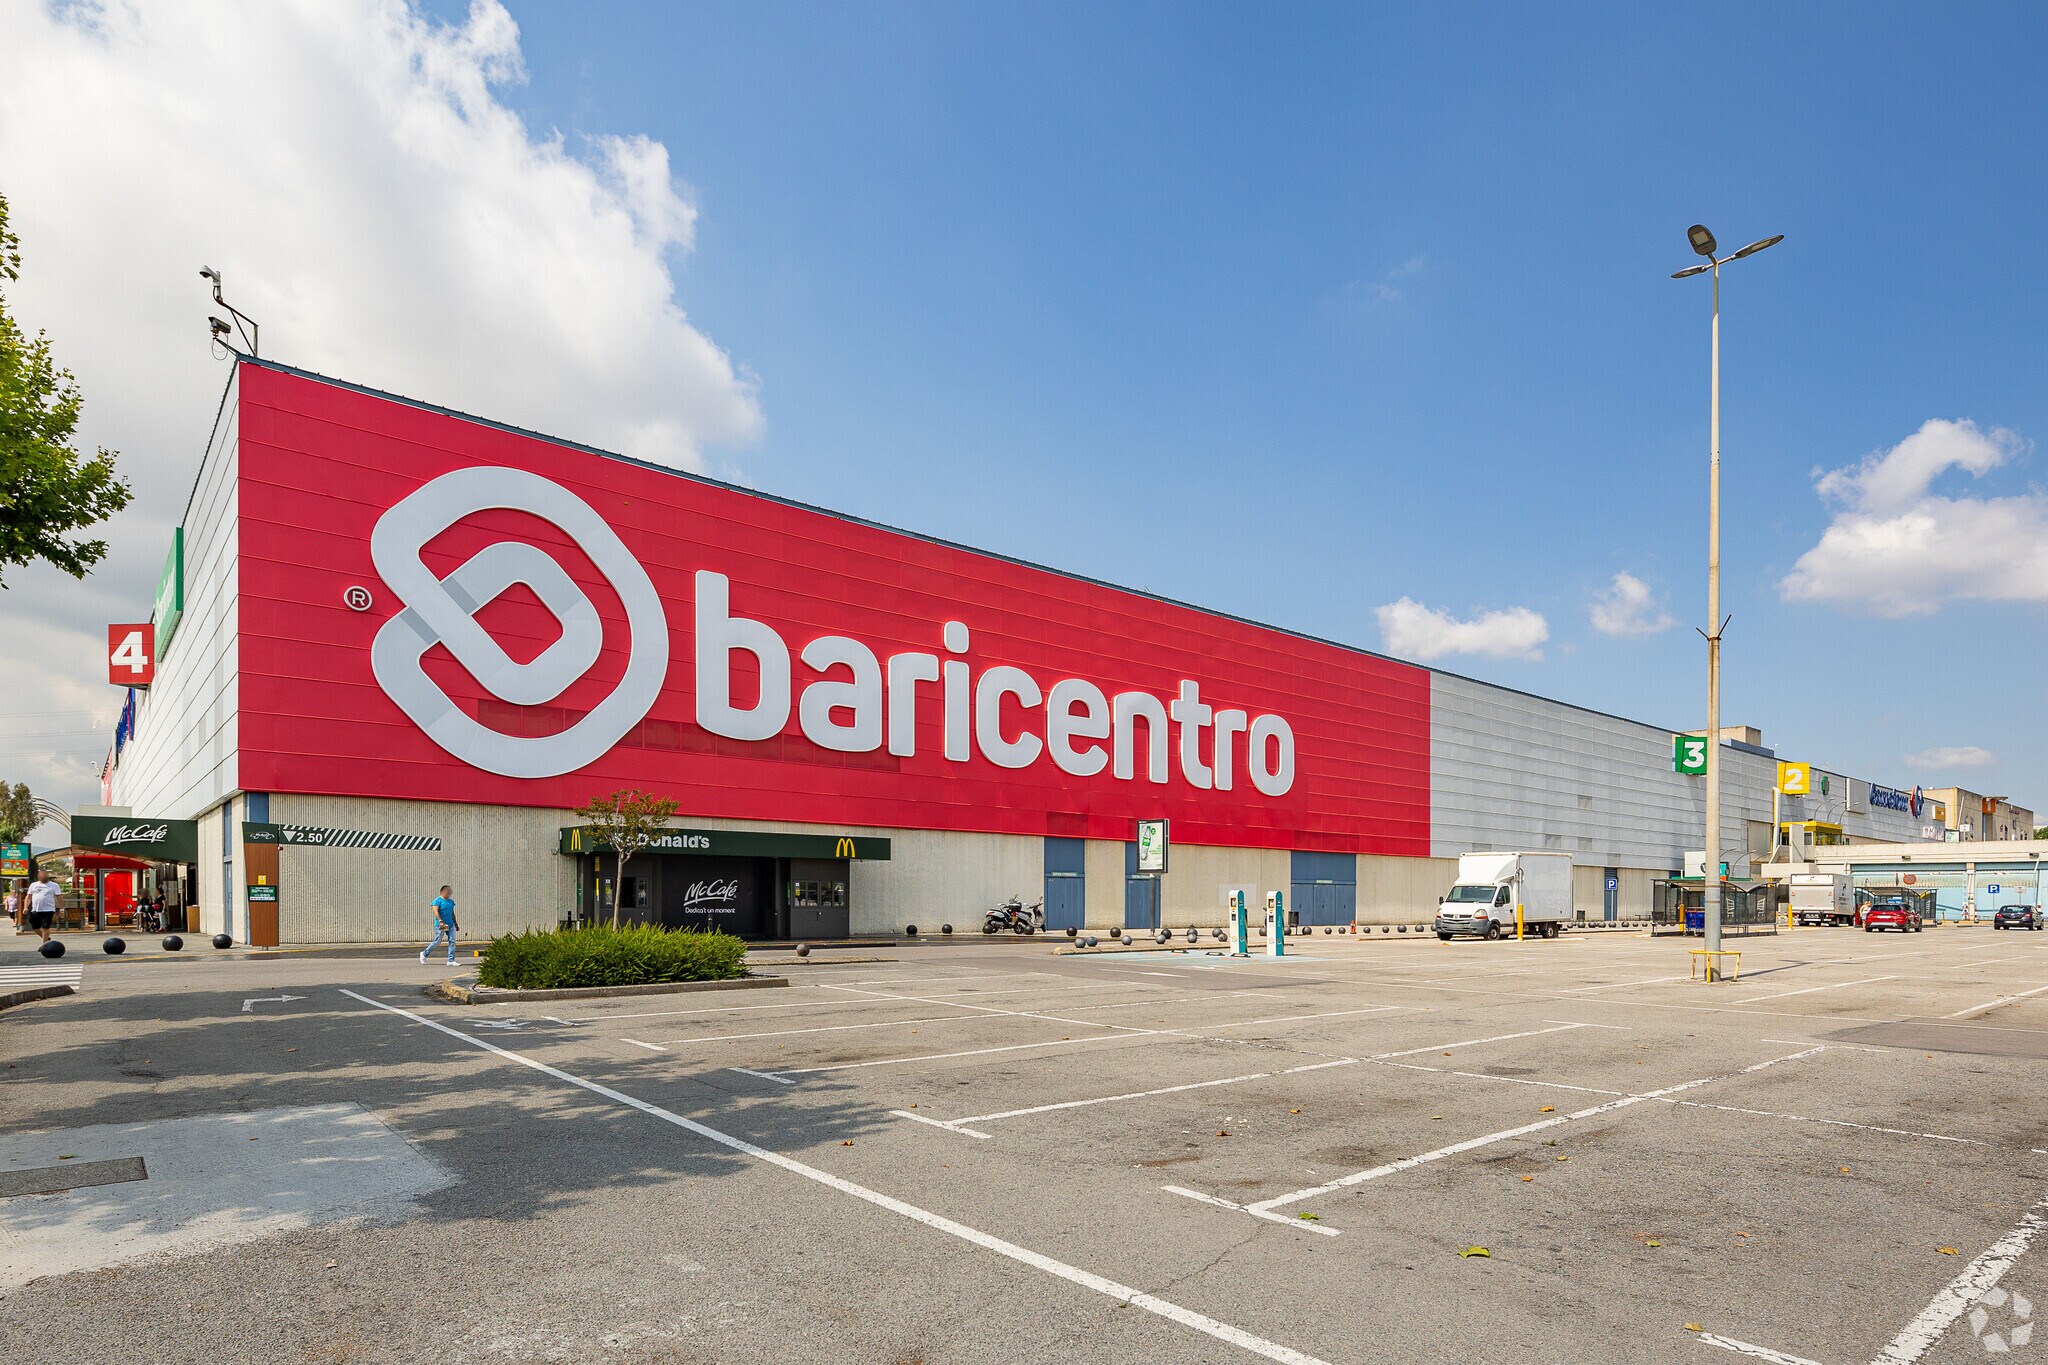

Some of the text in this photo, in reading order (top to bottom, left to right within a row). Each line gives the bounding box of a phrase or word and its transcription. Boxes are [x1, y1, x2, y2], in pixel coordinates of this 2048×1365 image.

[111, 631, 148, 674] 4
[695, 569, 1296, 797] baricentro
[1682, 741, 1705, 768] 3
[1784, 768, 1803, 790] 2
[103, 823, 168, 845] McCafé
[296, 832, 323, 843] 2.50
[683, 879, 738, 906] McCafé
[1608, 880, 1616, 889] P
[1989, 885, 1998, 893] P
